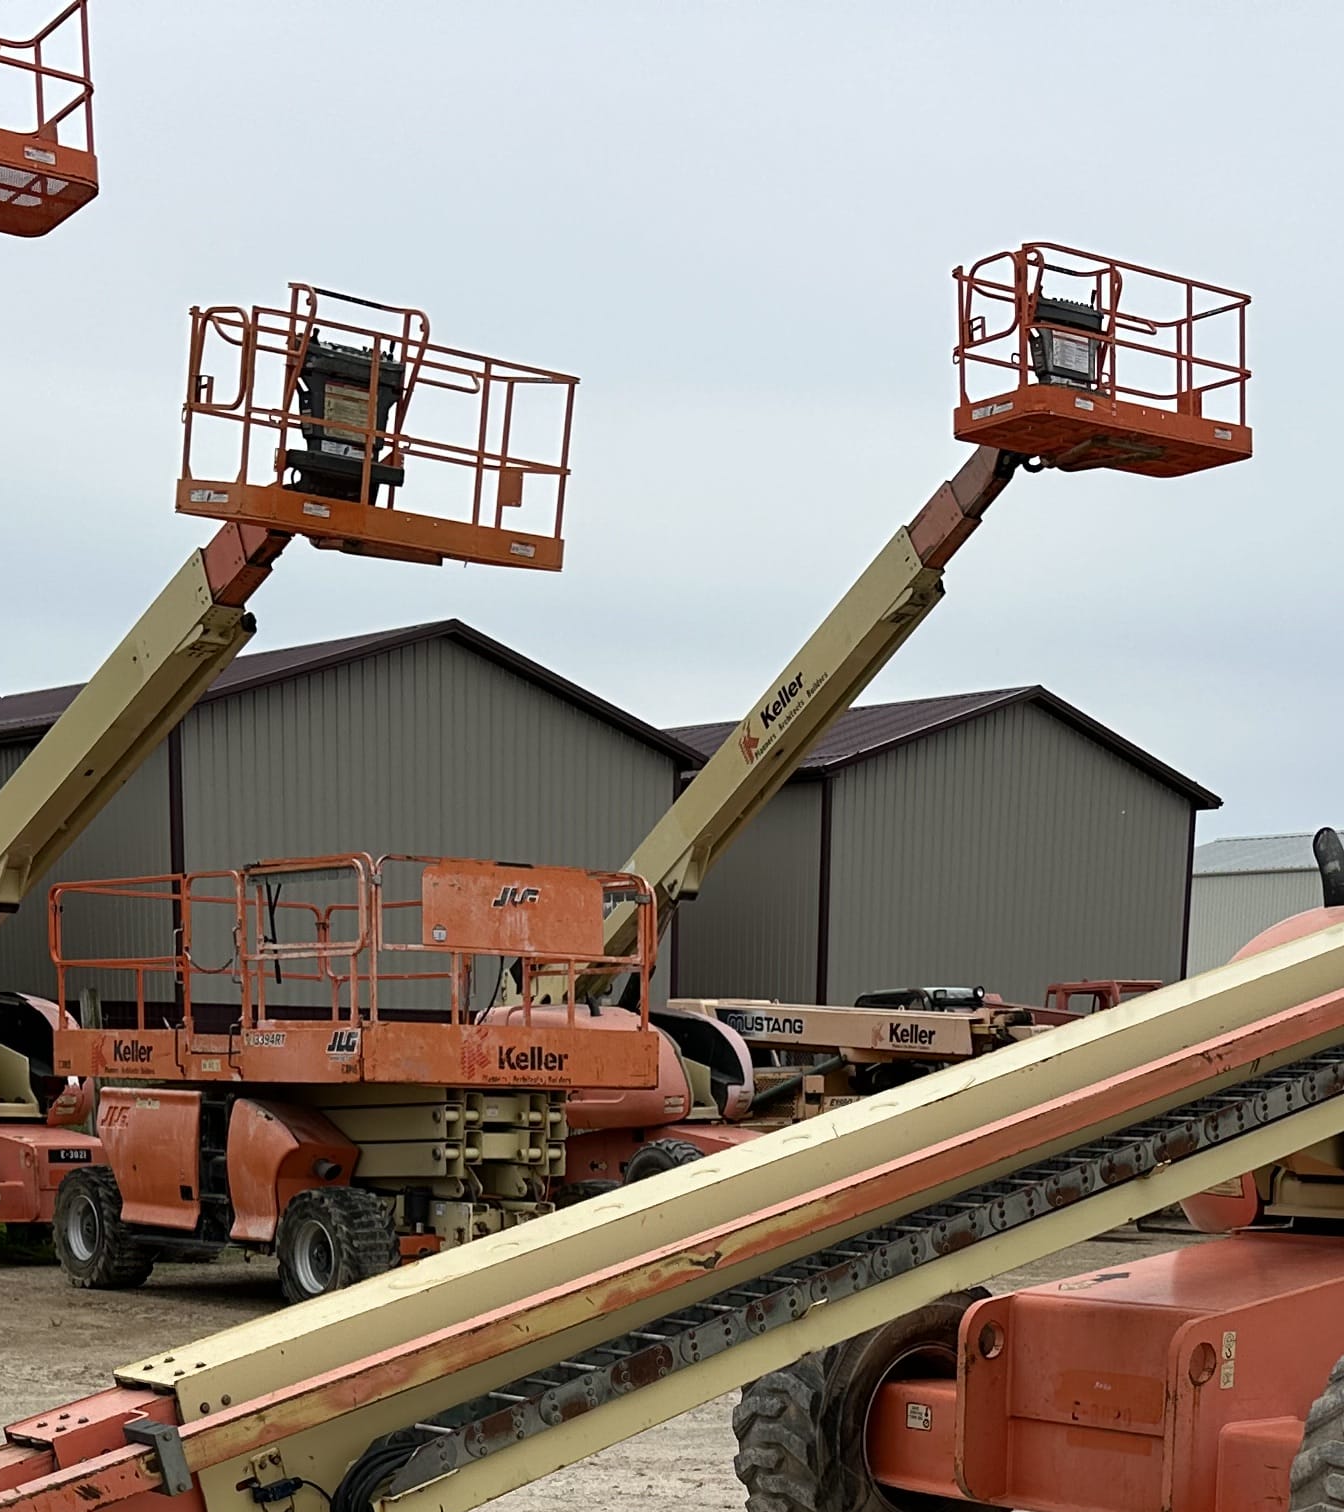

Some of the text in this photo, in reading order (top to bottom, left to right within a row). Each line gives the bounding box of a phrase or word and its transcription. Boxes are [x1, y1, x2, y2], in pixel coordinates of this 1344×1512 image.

[760, 671, 803, 729] Keller
[727, 1012, 805, 1034] MUSTANG
[889, 1022, 936, 1045] Keller
[113, 1039, 153, 1063] Keller
[327, 1031, 359, 1053] JLG
[498, 1046, 569, 1071] Keller
